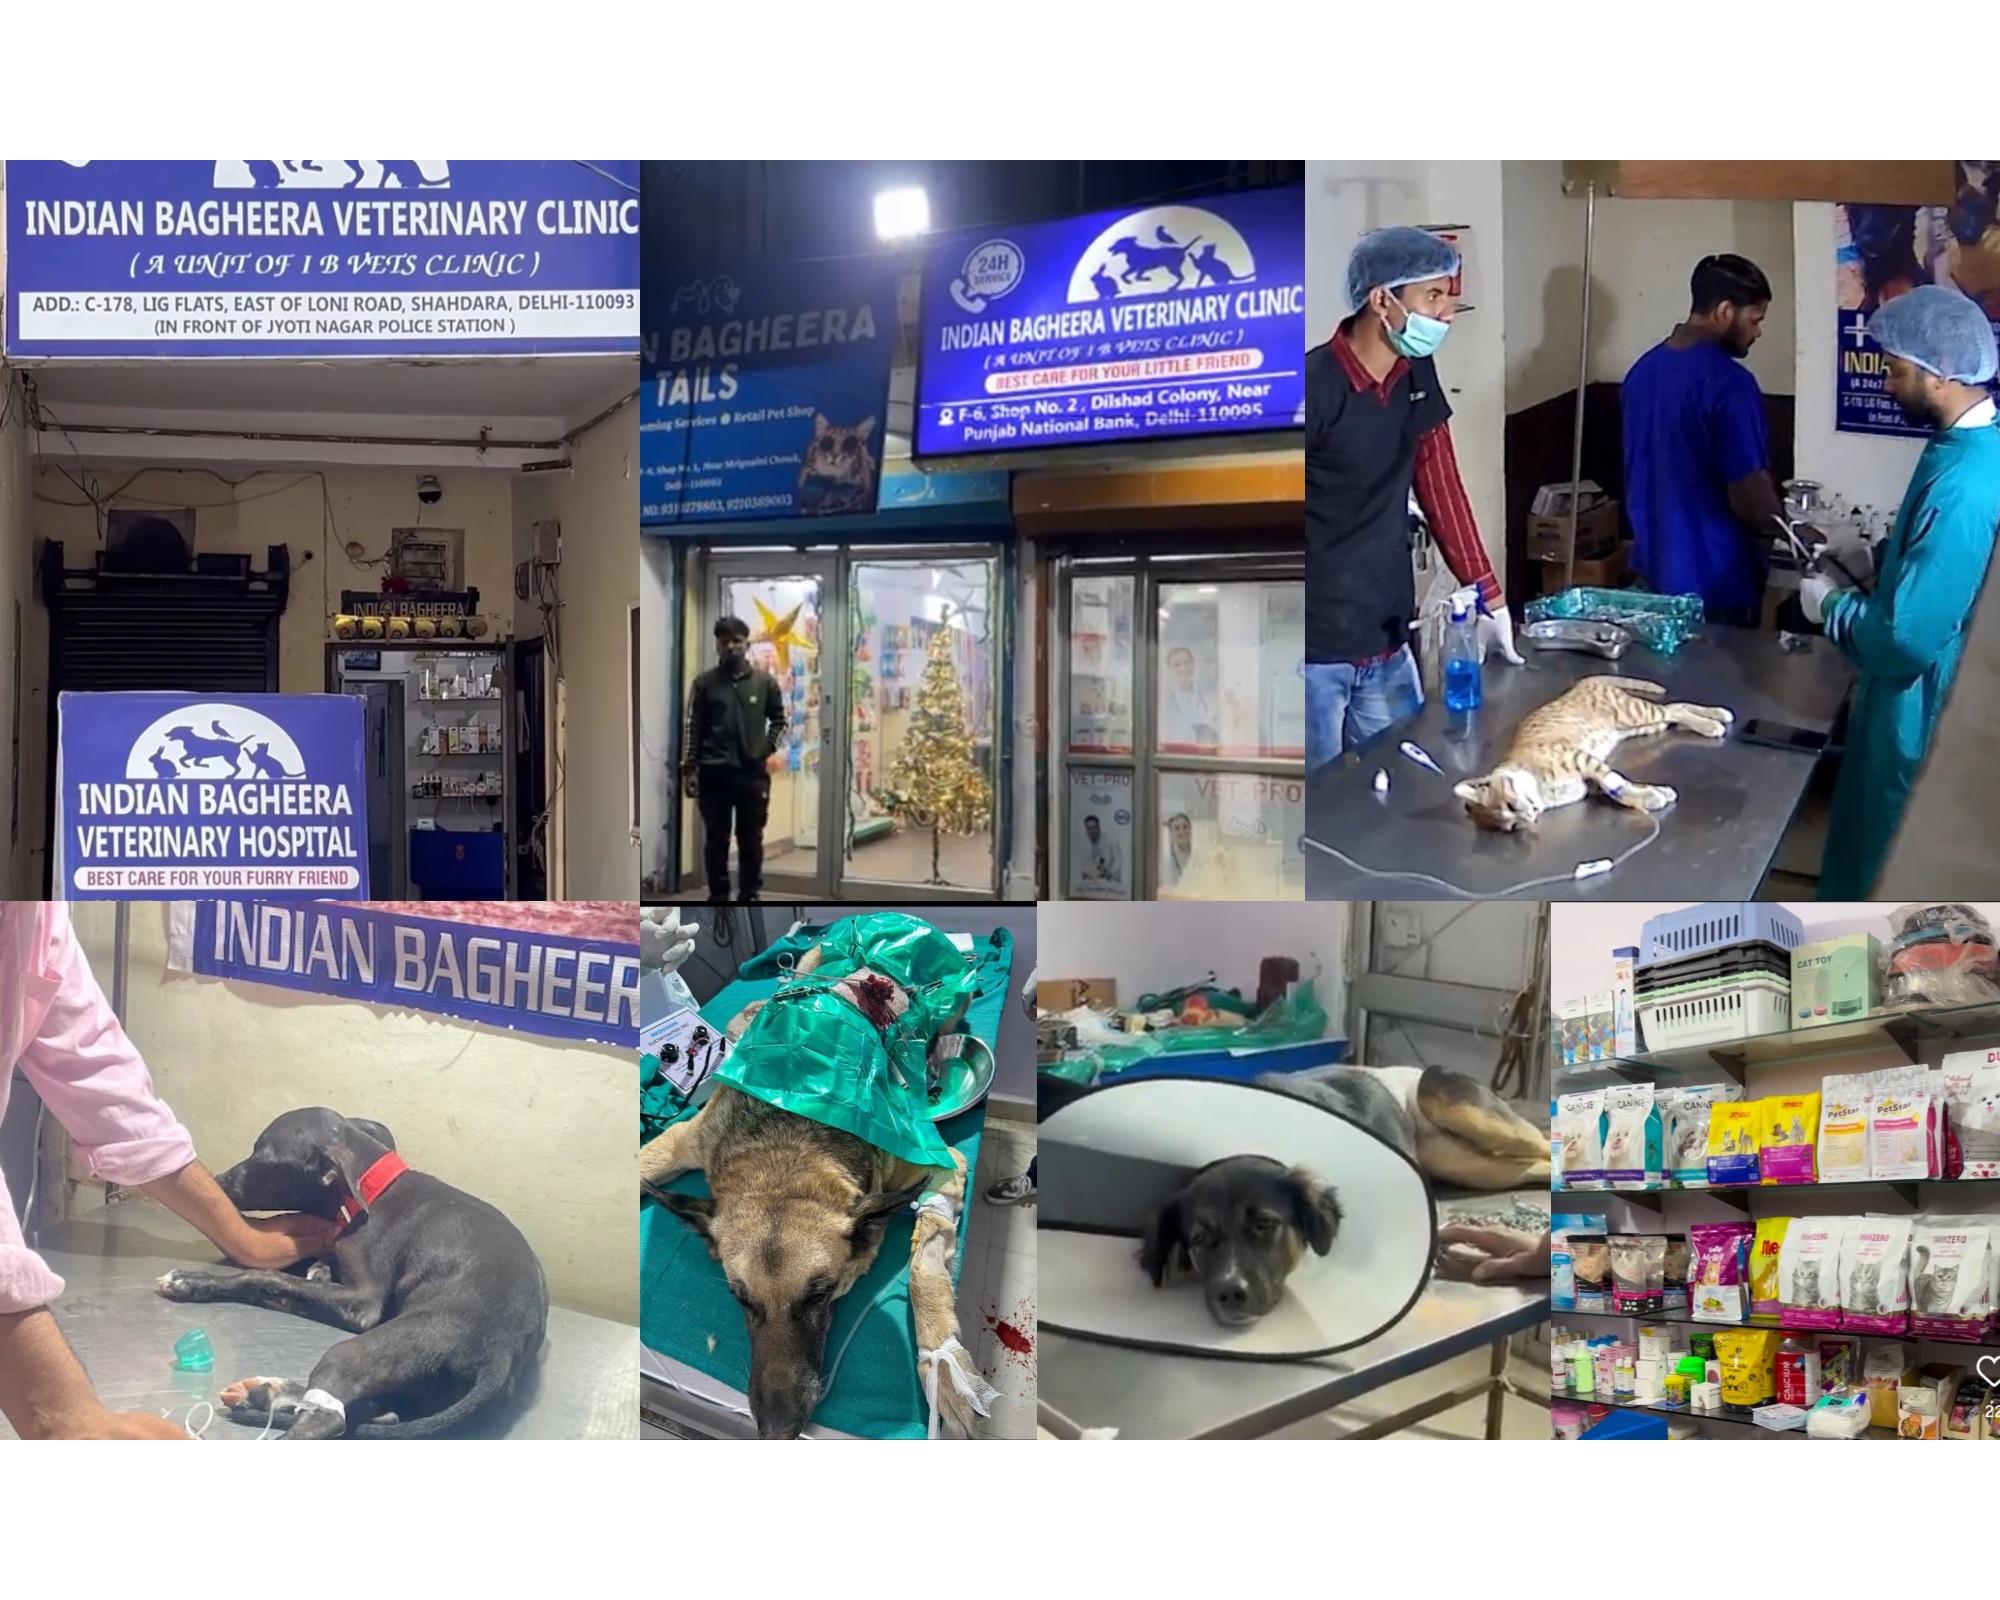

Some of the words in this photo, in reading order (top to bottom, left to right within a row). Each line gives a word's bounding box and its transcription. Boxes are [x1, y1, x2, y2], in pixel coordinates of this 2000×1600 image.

[25, 200, 144, 236] INDIAN
[156, 200, 324, 237] BAGHEERA
[332, 200, 526, 236] VETERINARY
[537, 199, 638, 235] CLINIC
[145, 254, 166, 275] A
[173, 252, 252, 278] UNIT
[254, 252, 296, 278] OF
[301, 253, 312, 276] I
[320, 253, 340, 276] B
[347, 252, 418, 277] VETS
[424, 252, 524, 278] CLINIC
[978, 254, 1009, 274] 24H
[33, 297, 80, 313] ADD.:
[84, 297, 137, 316] C-178,
[142, 297, 171, 313] LIG
[174, 296, 228, 316] FLATS,
[234, 296, 274, 313] EAST
[280, 296, 302, 312] OF
[307, 296, 348, 312] LONI
[353, 295, 408, 315] ROAD,
[411, 295, 513, 315] SHAHDARA,
[518, 294, 635, 312] DELHI-110093
[941, 321, 1006, 351] INDIAN
[1009, 308, 1105, 343] BAGHEERA
[1111, 294, 1230, 333] VETERINARY
[1235, 285, 1304, 316] CLINIC
[154, 319, 178, 337] (IN
[182, 319, 237, 335] FRONT
[242, 319, 264, 334] OF
[266, 318, 311, 334] JYOTI
[316, 319, 374, 335] NAGAR
[379, 318, 434, 334] POLICE
[437, 318, 506, 334] STATION
[670, 305, 876, 362] BAGHEERA
[1058, 346, 1083, 362] OF
[1114, 336, 1161, 356] VETS
[1165, 331, 1234, 352] CLINIC
[655, 364, 739, 408] TAILS
[996, 373, 1028, 391] BEST
[1032, 370, 1069, 388] CARE
[1071, 367, 1099, 384] FOR
[1103, 364, 1141, 381] YOUR
[1145, 358, 1194, 377] LITTLE
[1197, 353, 1251, 374] FRIEND
[733, 410, 766, 424] Retail
[767, 408, 785, 420] Pet
[787, 406, 816, 420] Shop
[959, 407, 988, 424] F-6,
[991, 403, 1030, 423] Shop
[1034, 400, 1068, 416] No.
[1091, 393, 1154, 413] Dilshad
[1158, 388, 1222, 409] Colony,
[1227, 383, 1272, 400] Near
[964, 422, 1017, 444] Punjab
[1021, 417, 1089, 438] National
[1094, 414, 1140, 431] Bank,
[1145, 403, 1263, 427] Delhi-110095
[353, 602, 395, 617] INDIAN
[400, 602, 465, 617] BAGHEERA
[79, 783, 190, 816] INDIAN
[199, 783, 353, 816] BAGHEERA
[77, 826, 232, 859] VETERINARY
[239, 826, 357, 859] HOSPITAL
[87, 870, 124, 887] BEST
[128, 870, 166, 887] CARE
[170, 870, 199, 886] FOR
[202, 870, 243, 886] YOUR
[247, 870, 294, 887] FURRY
[298, 870, 349, 886] FRIEND
[214, 901, 376, 985] INDIAN
[1797, 957, 1813, 969] CAT
[1815, 955, 1833, 966] TOY
[1617, 1099, 1645, 1109] CANINE
[1828, 1107, 1860, 1118] PetStar
[1877, 1101, 1912, 1114] PetStar
